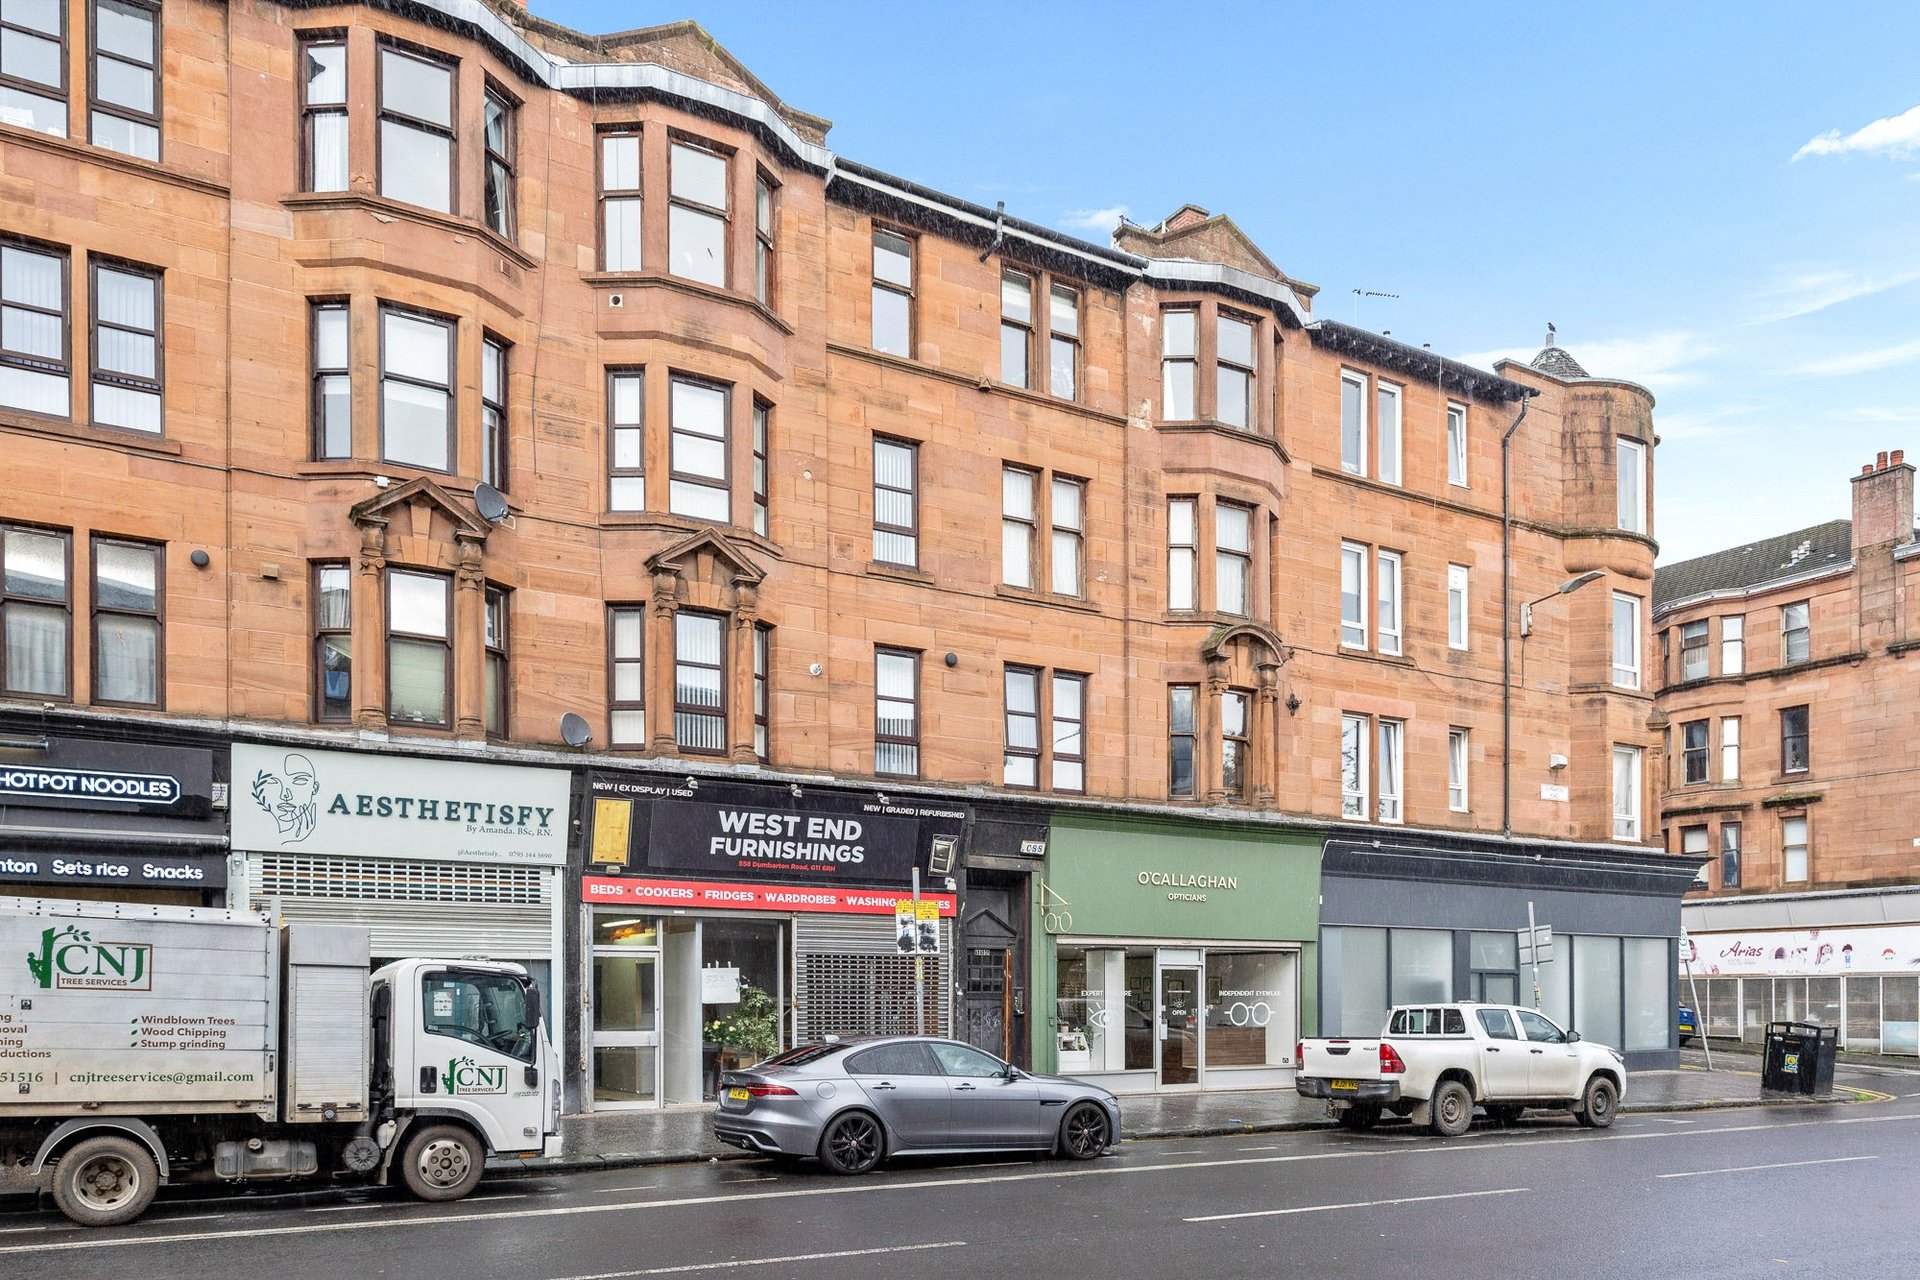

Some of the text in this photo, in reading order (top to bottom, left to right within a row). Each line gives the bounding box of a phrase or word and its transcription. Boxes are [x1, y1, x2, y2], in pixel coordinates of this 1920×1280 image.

[81, 777, 170, 796] NOODLES
[593, 782, 693, 797] NEW EX DISPLAY USED
[328, 793, 555, 827] AESTHETISFY
[863, 804, 965, 819] NEW GRADED REFURBISHED
[466, 824, 477, 834] By
[719, 810, 863, 841] WEST END
[710, 836, 865, 864] FURNISHINGS
[53, 859, 93, 876] Sets
[96, 862, 129, 877] rice
[143, 863, 203, 880] Snacks
[752, 862, 790, 870] Dumbarton
[1137, 871, 1238, 889] O'CALLAGHAN
[590, 884, 623, 895] BEDS
[635, 886, 694, 899] COOKERS
[705, 890, 754, 901] FRIDGES
[765, 892, 837, 905] WARDROBES
[846, 896, 896, 907] WASHING
[1168, 892, 1207, 902] OPTICIANS
[1720, 941, 1763, 958] Arias
[56, 944, 149, 983] CNJ
[61, 977, 128, 986] TREE SERVICES
[141, 1015, 236, 1026] Windblown Trees
[0, 1024, 28, 1034] oval
[141, 1027, 227, 1038] Wood Chipping
[141, 1039, 226, 1051] Stump grinding
[69, 1071, 255, 1085] cnjtreeservices@gmail.com
[456, 1067, 505, 1090] CNJ
